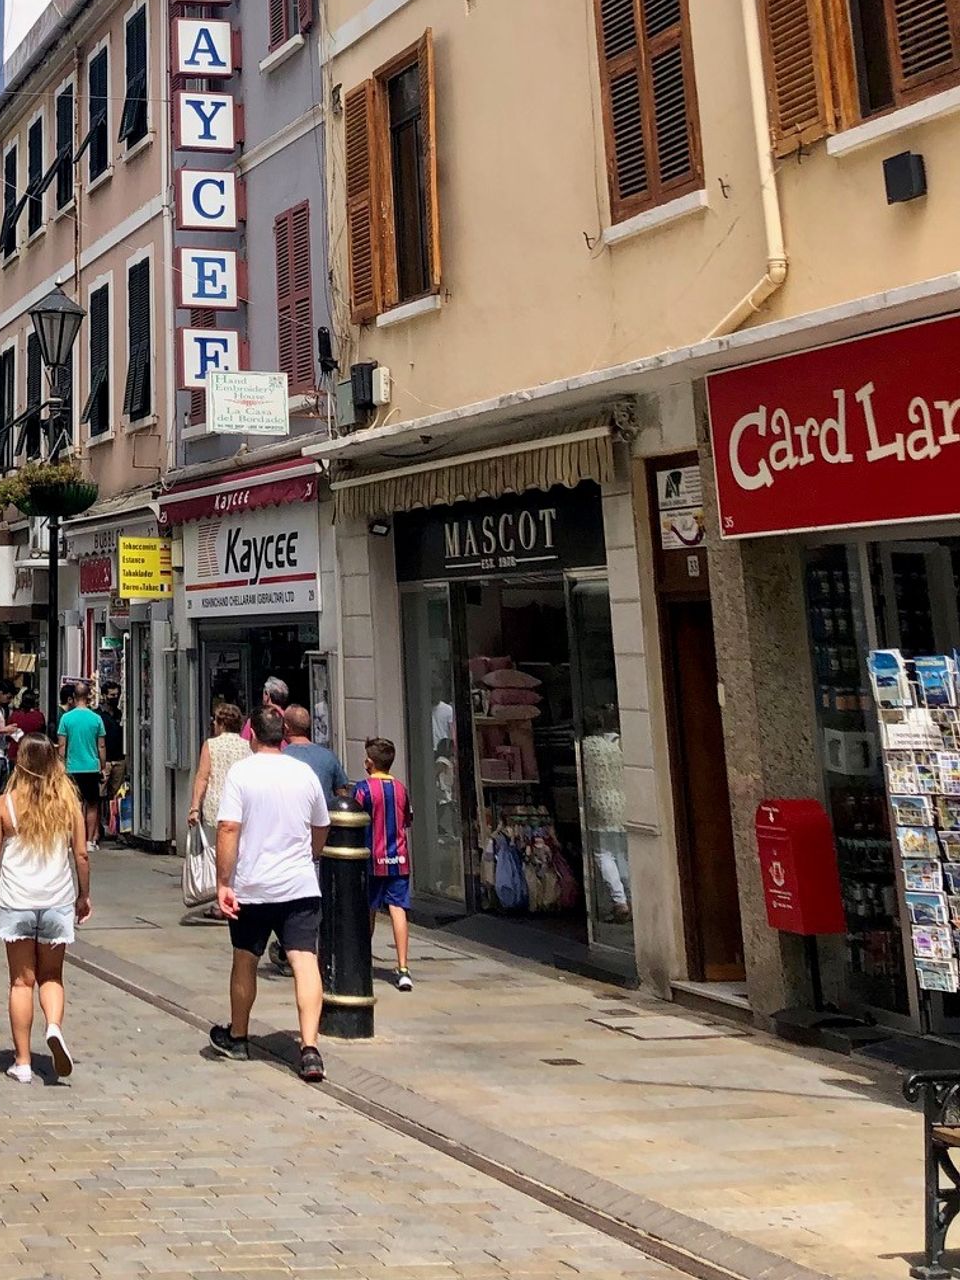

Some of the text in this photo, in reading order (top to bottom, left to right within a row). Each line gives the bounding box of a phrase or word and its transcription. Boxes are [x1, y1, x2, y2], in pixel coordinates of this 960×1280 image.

[216, 375, 247, 384] Hand
[216, 384, 273, 393] Embroidery
[729, 389, 853, 490] Card
[444, 508, 556, 558] MASCOT
[284, 591, 295, 602] LTD
